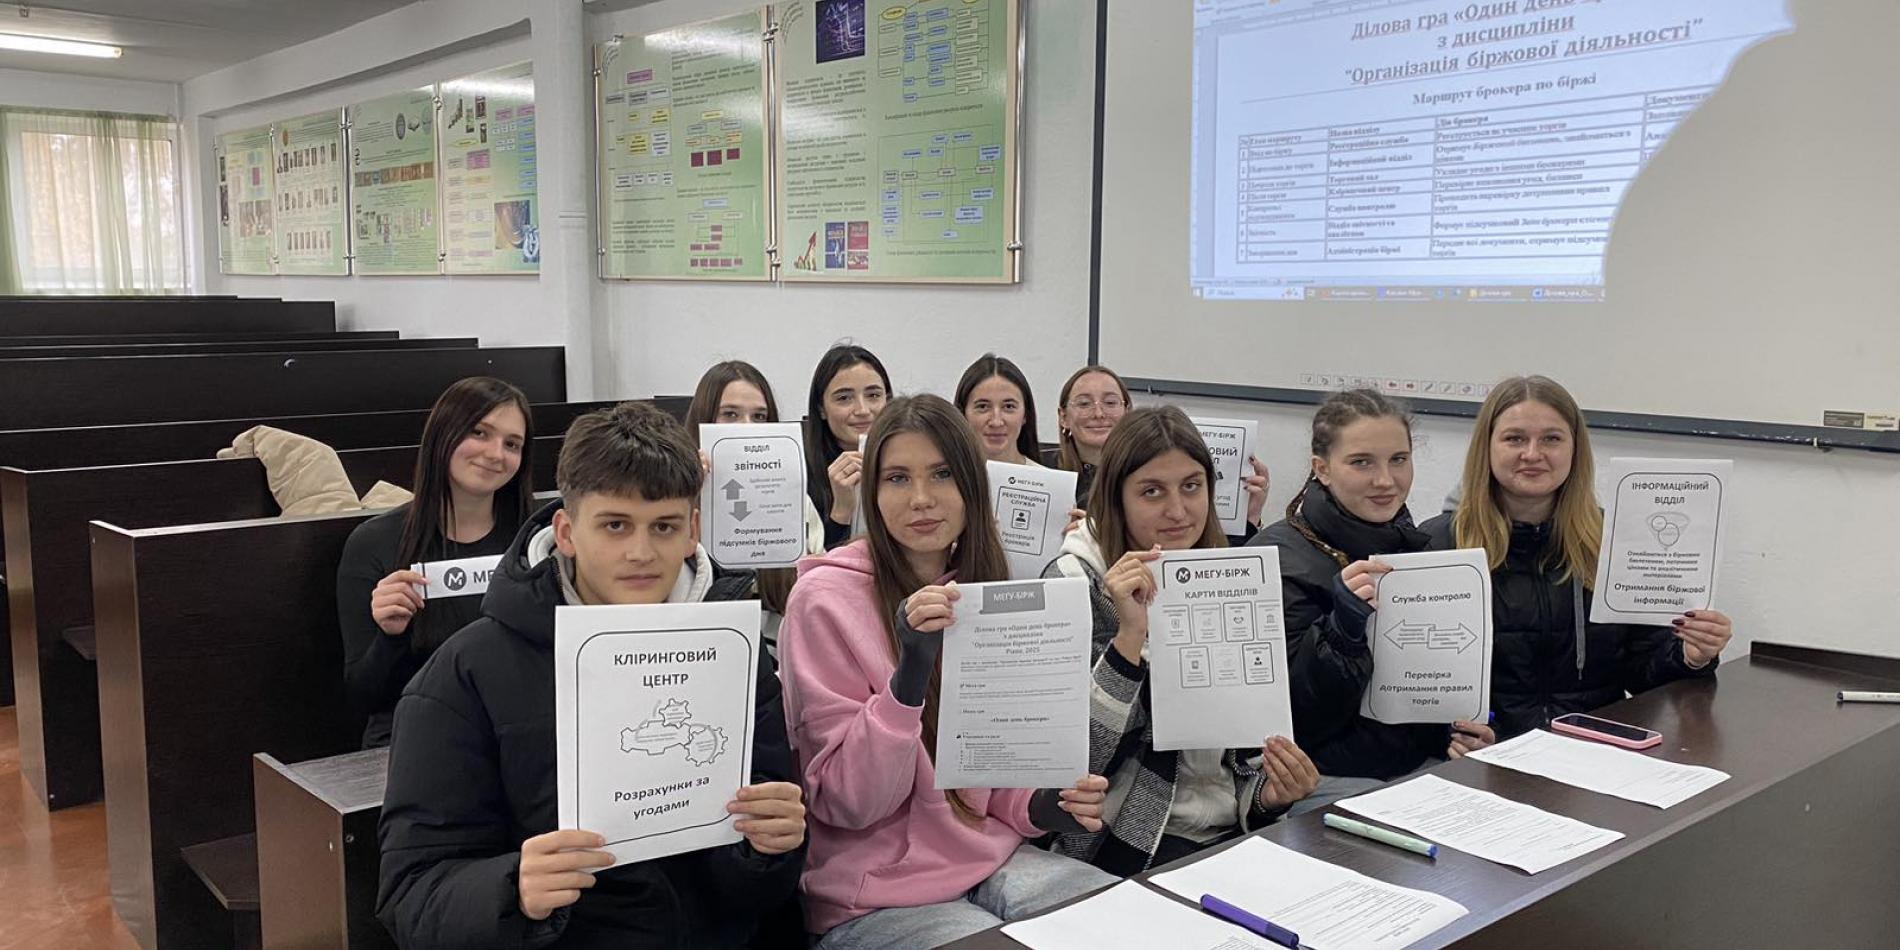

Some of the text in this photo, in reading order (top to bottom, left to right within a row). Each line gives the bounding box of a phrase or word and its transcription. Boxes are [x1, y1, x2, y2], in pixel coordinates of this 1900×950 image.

[1351, 18, 1411, 41] Ділова
[1417, 12, 1448, 30] гра
[1437, 15, 1575, 48] з дисципліни
[1467, 40, 1558, 69] біржової
[1413, 73, 1597, 106] Маршрут брокера по біржі
[1208, 446, 1238, 457] ОВИЙ
[1632, 481, 1709, 491] ІНФОРМАЦІЙНИЙ
[1654, 496, 1685, 505] ВІДДІЛ
[1185, 588, 1258, 599] КАРТИ ВІДДІЛІВ
[1614, 582, 1706, 594] Отримання біржової
[1392, 592, 1471, 604] Служба контролю
[1633, 596, 1685, 606] інформації
[614, 647, 717, 666] КЛІРИНГОВИЙ
[643, 673, 689, 688] ЦЕНТР
[1404, 671, 1452, 681] Перевірка
[1379, 683, 1473, 693] дотримання правил
[1412, 697, 1440, 706] торгів
[614, 776, 710, 802] Розрахунки за
[633, 798, 690, 820] угодами
